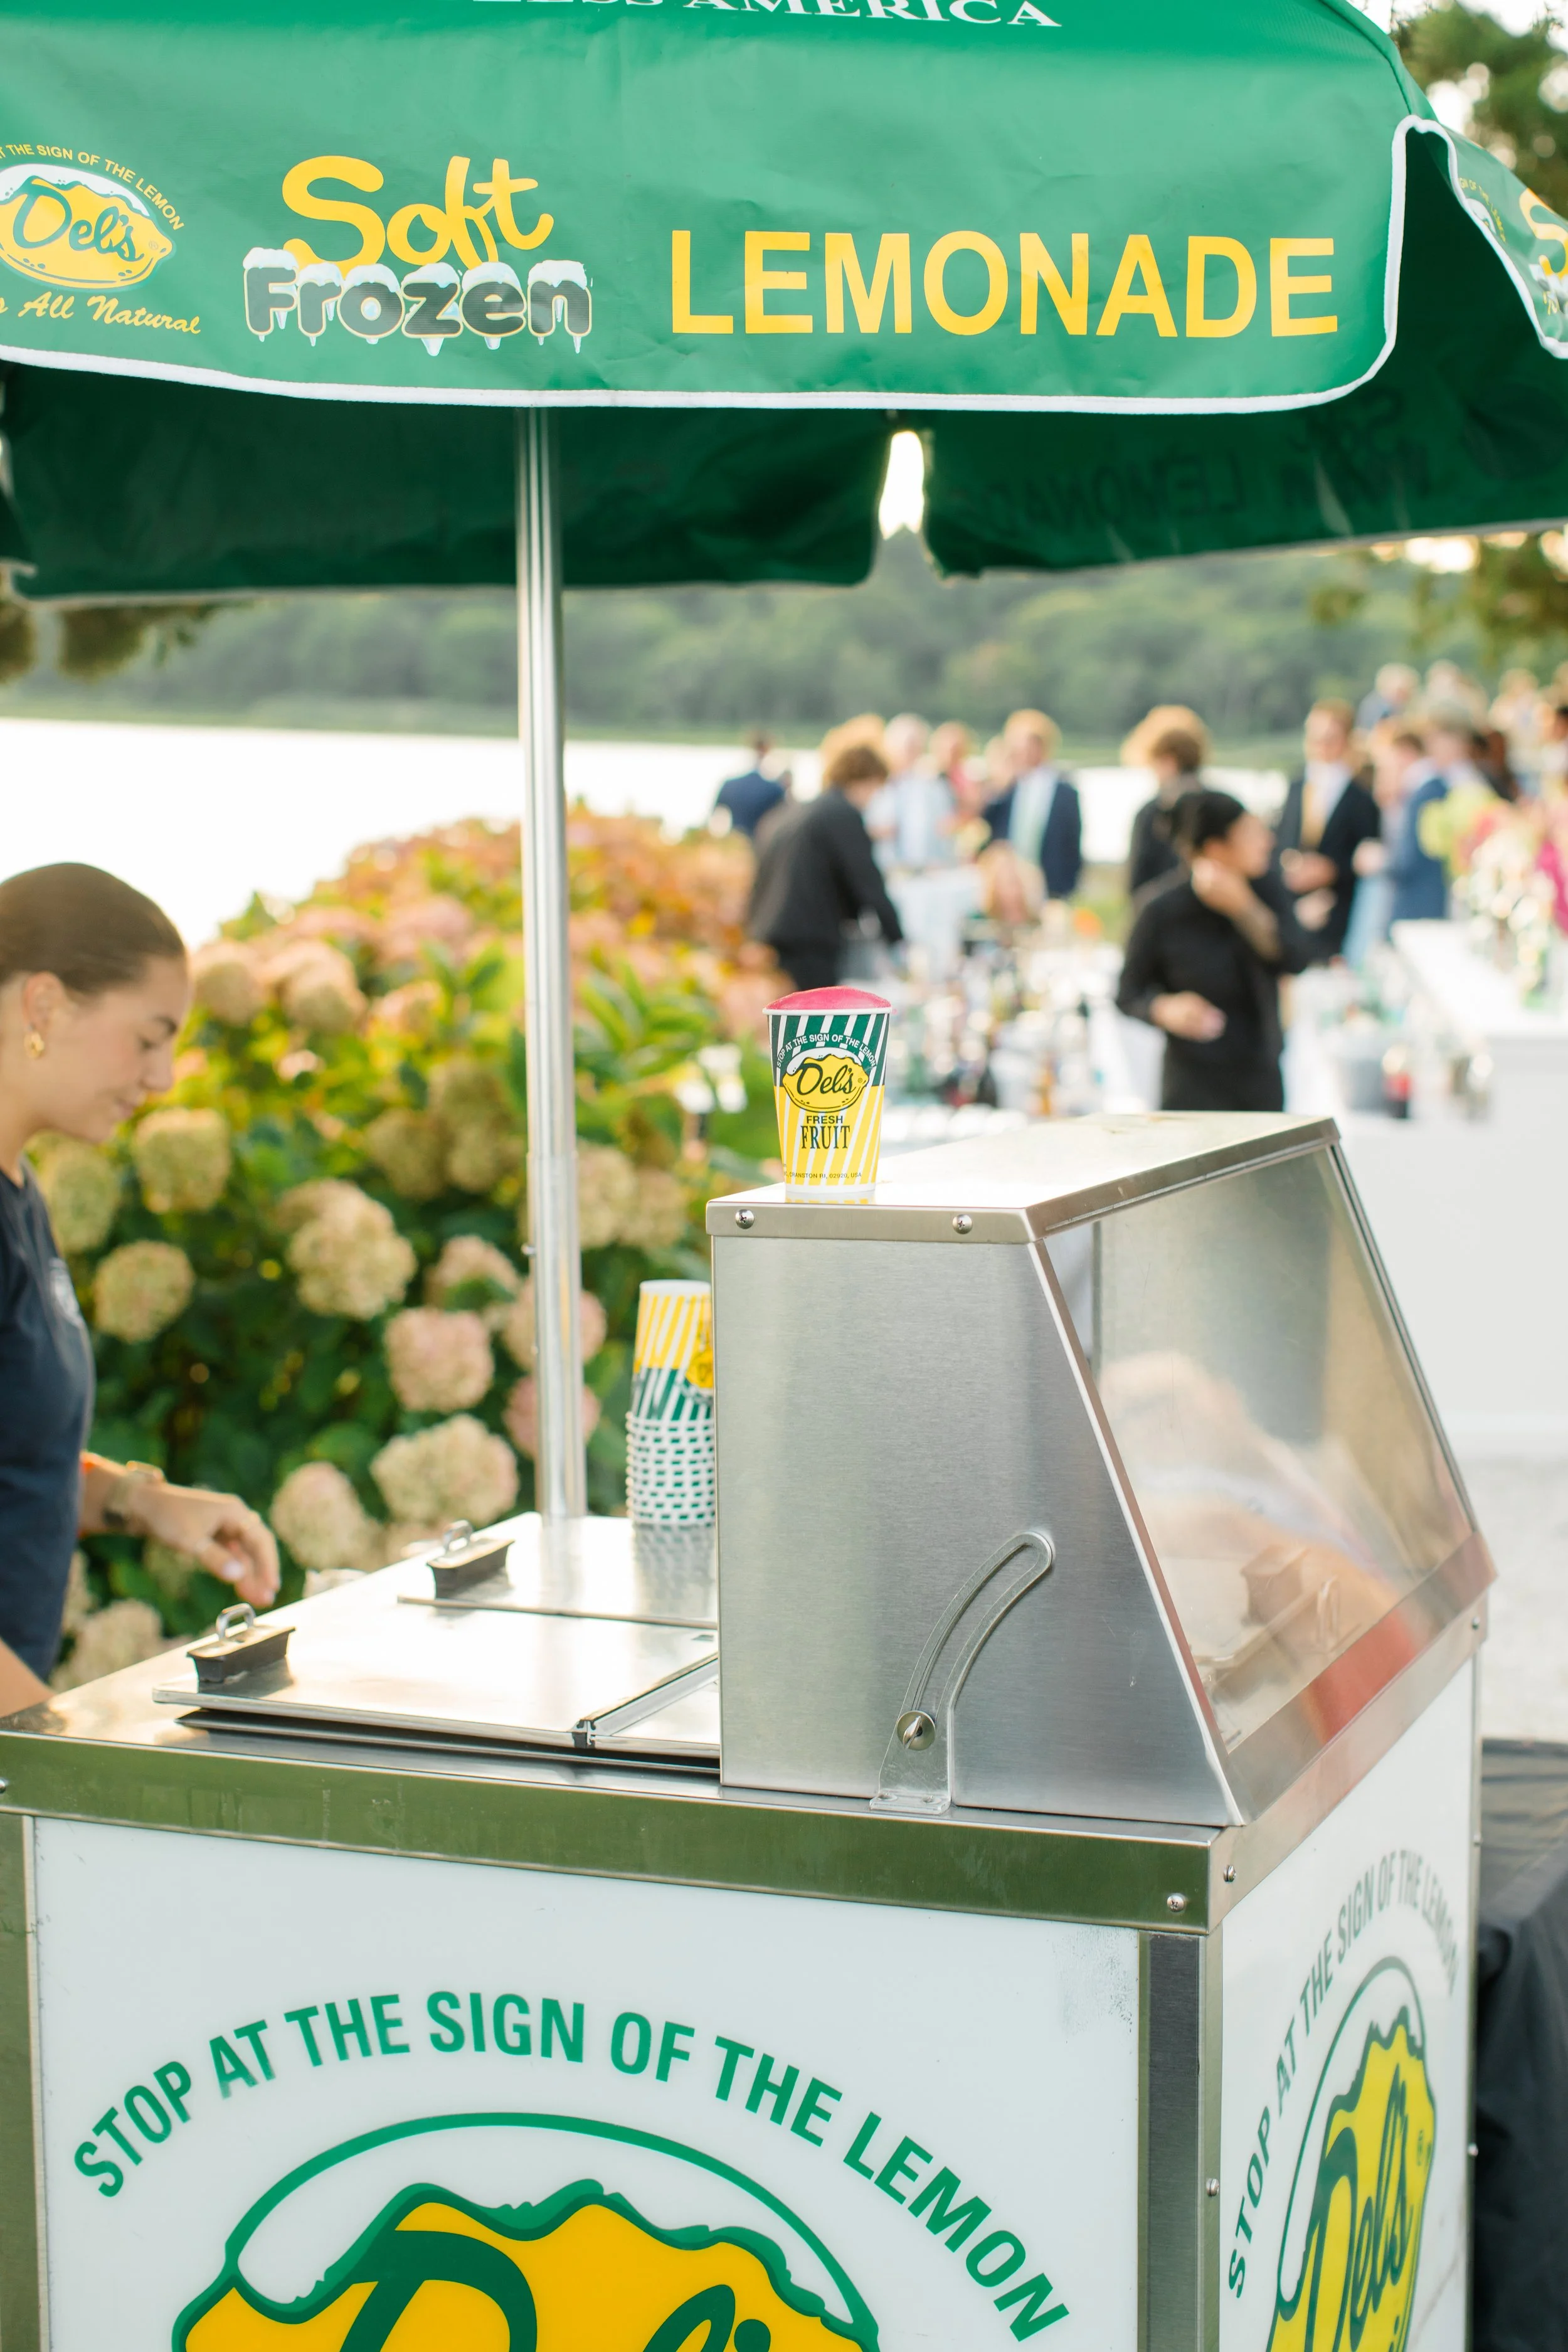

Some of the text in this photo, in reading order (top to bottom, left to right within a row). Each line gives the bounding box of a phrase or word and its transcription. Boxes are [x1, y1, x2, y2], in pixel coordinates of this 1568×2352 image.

[6, 144, 34, 156] THE
[36, 145, 73, 160] SIGN
[78, 152, 100, 166] OF
[104, 159, 136, 183] THE
[135, 178, 184, 230] LEMON
[13, 182, 145, 262] Del's
[282, 156, 554, 279] Soft
[18, 291, 75, 319] All
[87, 295, 201, 334] Natural
[243, 247, 592, 348] Frozen
[672, 230, 1338, 338] LEMONADE
[777, 1034, 877, 1067] STOP AT THE SIGN OF THE LEMON
[797, 1063, 856, 1095] Del's
[801, 1125, 850, 1149] FRUIT
[807, 1116, 843, 1124] FRESH
[1228, 2106, 1271, 2299] STOP
[1276, 2017, 1299, 2118] AT
[1300, 1929, 1333, 2040] THE
[1337, 1863, 1375, 1965] SIGN
[1378, 1850, 1397, 1913] OF
[74, 2061, 192, 2197] STOP
[209, 2020, 276, 2099] AT
[285, 1994, 410, 2067] THE
[426, 1991, 585, 2063] SIGN
[610, 2012, 695, 2082] OF
[715, 2036, 843, 2147] THE
[843, 2111, 1069, 2341] LEMON
